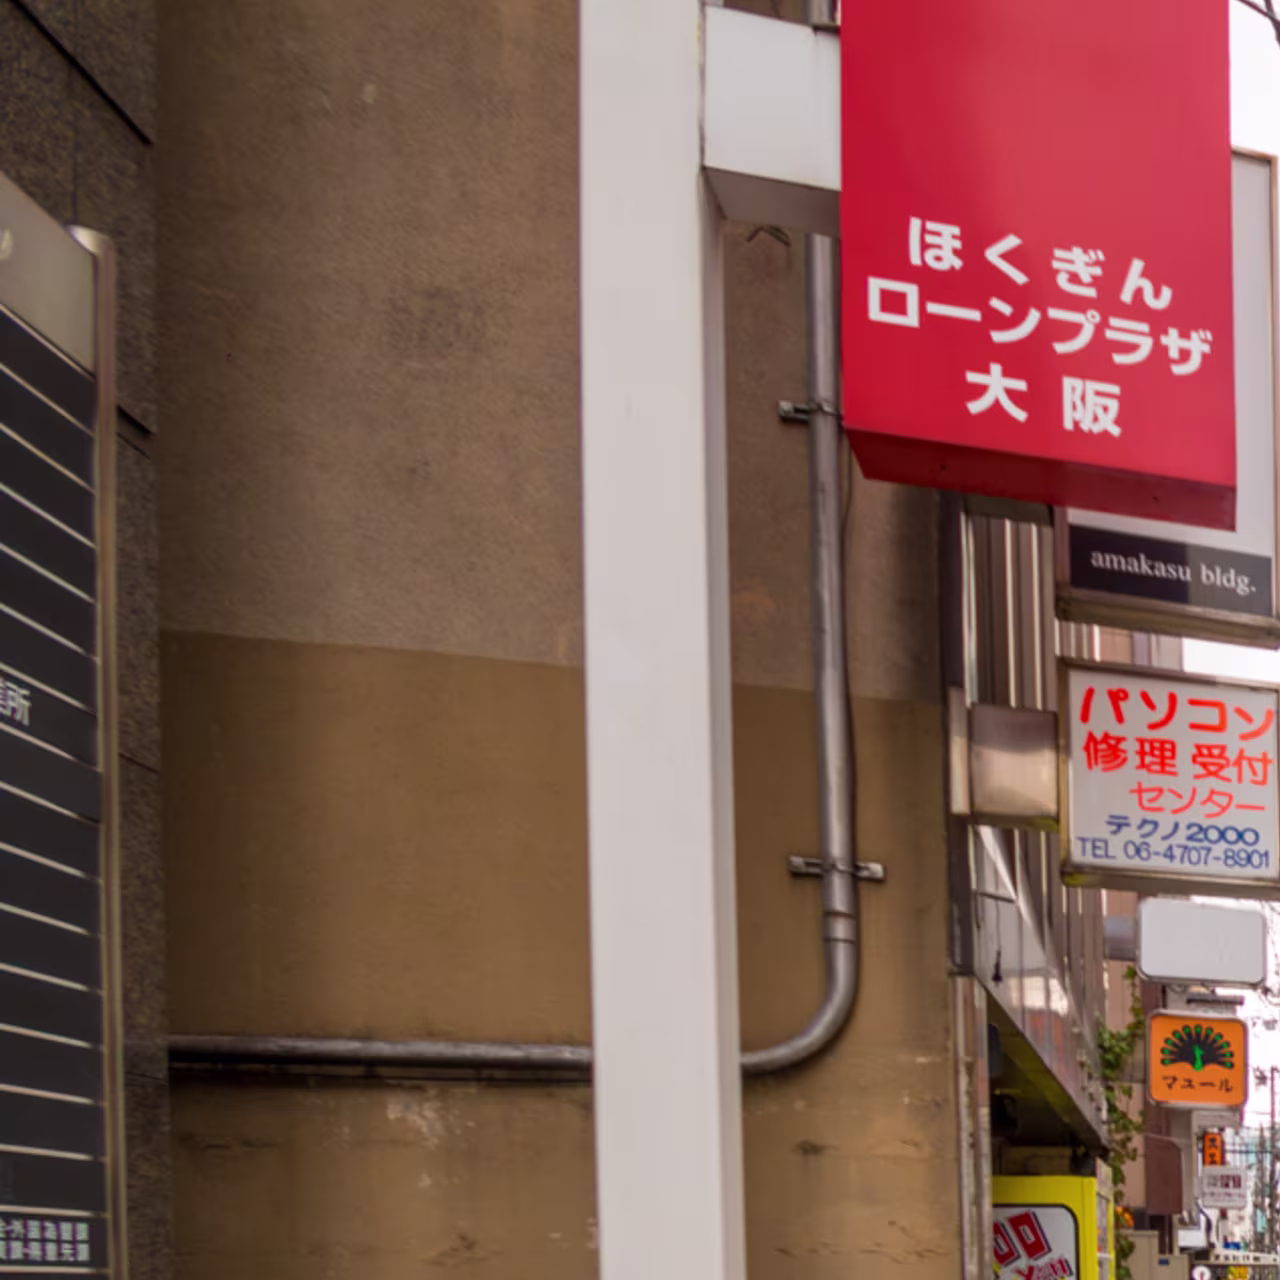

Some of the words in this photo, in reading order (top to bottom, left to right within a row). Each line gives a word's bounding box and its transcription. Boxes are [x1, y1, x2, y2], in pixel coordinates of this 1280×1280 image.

[909, 216, 1172, 311] ほくぎん
[867, 275, 1213, 376] ローンプラザ
[965, 362, 1122, 437] 大阪
[1090, 548, 1191, 581] amakasu
[1201, 563, 1256, 596] bldg.
[1079, 686, 1275, 742] パソコン
[1082, 731, 1273, 786] 修理受付
[1129, 781, 1265, 819] センター
[1076, 837, 1117, 860] TEL
[1124, 840, 1269, 869] 06-4707-8901
[1105, 814, 1260, 846] テクノ2000
